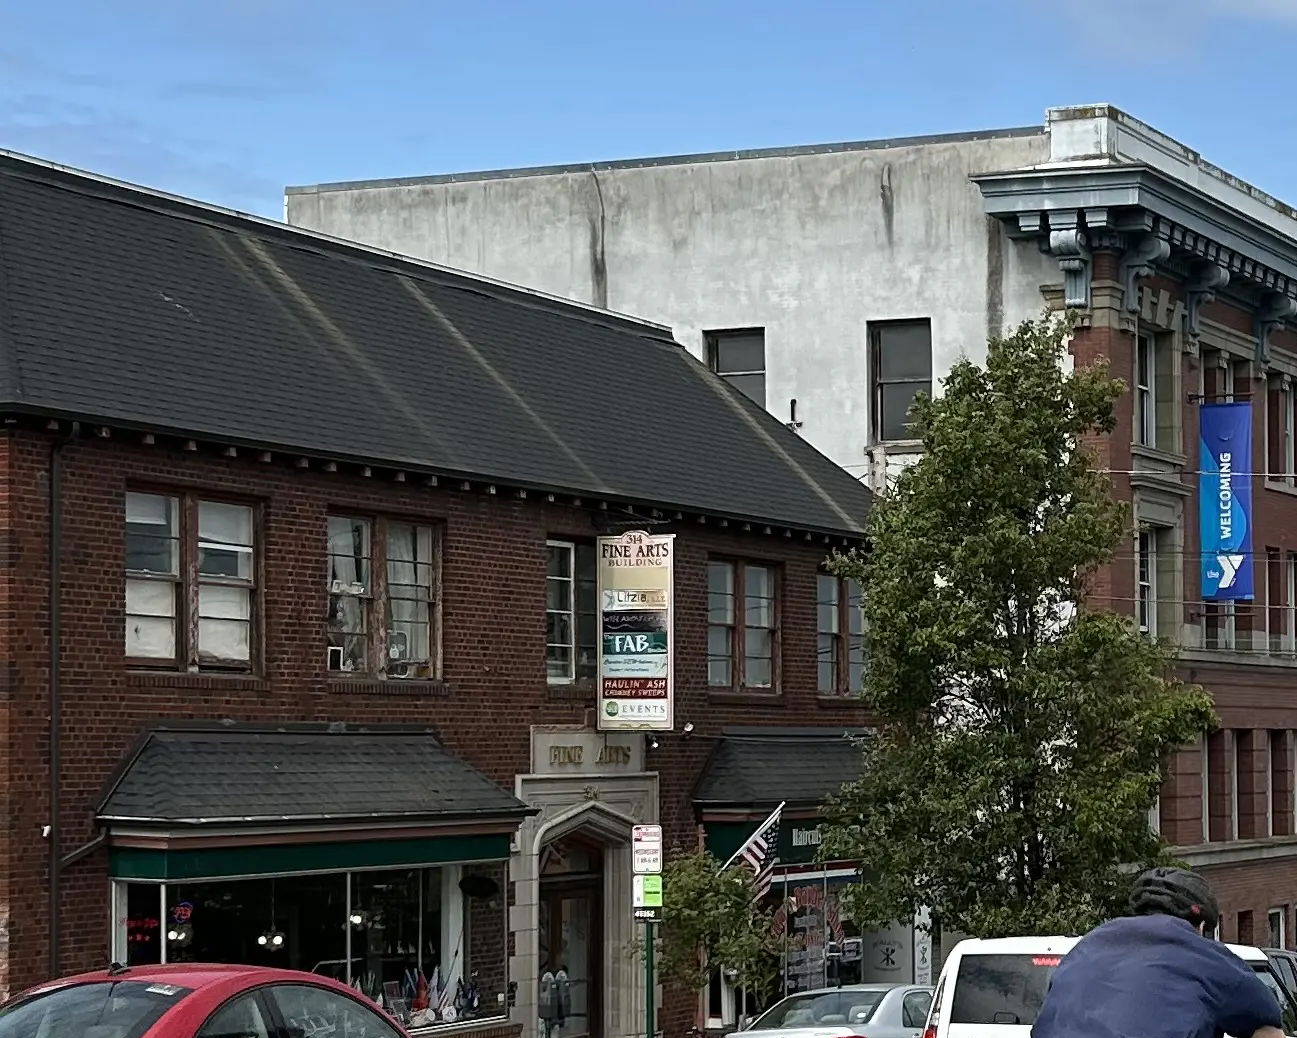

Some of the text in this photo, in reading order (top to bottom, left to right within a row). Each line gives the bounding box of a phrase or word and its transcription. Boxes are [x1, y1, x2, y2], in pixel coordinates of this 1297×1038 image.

[1220, 452, 1232, 540] WELCOMING
[626, 534, 643, 545] 314
[601, 542, 669, 559] FINE ARTS
[608, 558, 662, 567] BUILDING
[615, 634, 650, 653] FAB
[646, 679, 666, 689] ASH
[622, 704, 666, 714] EVENTS
[549, 745, 632, 766] FINE ARTS
